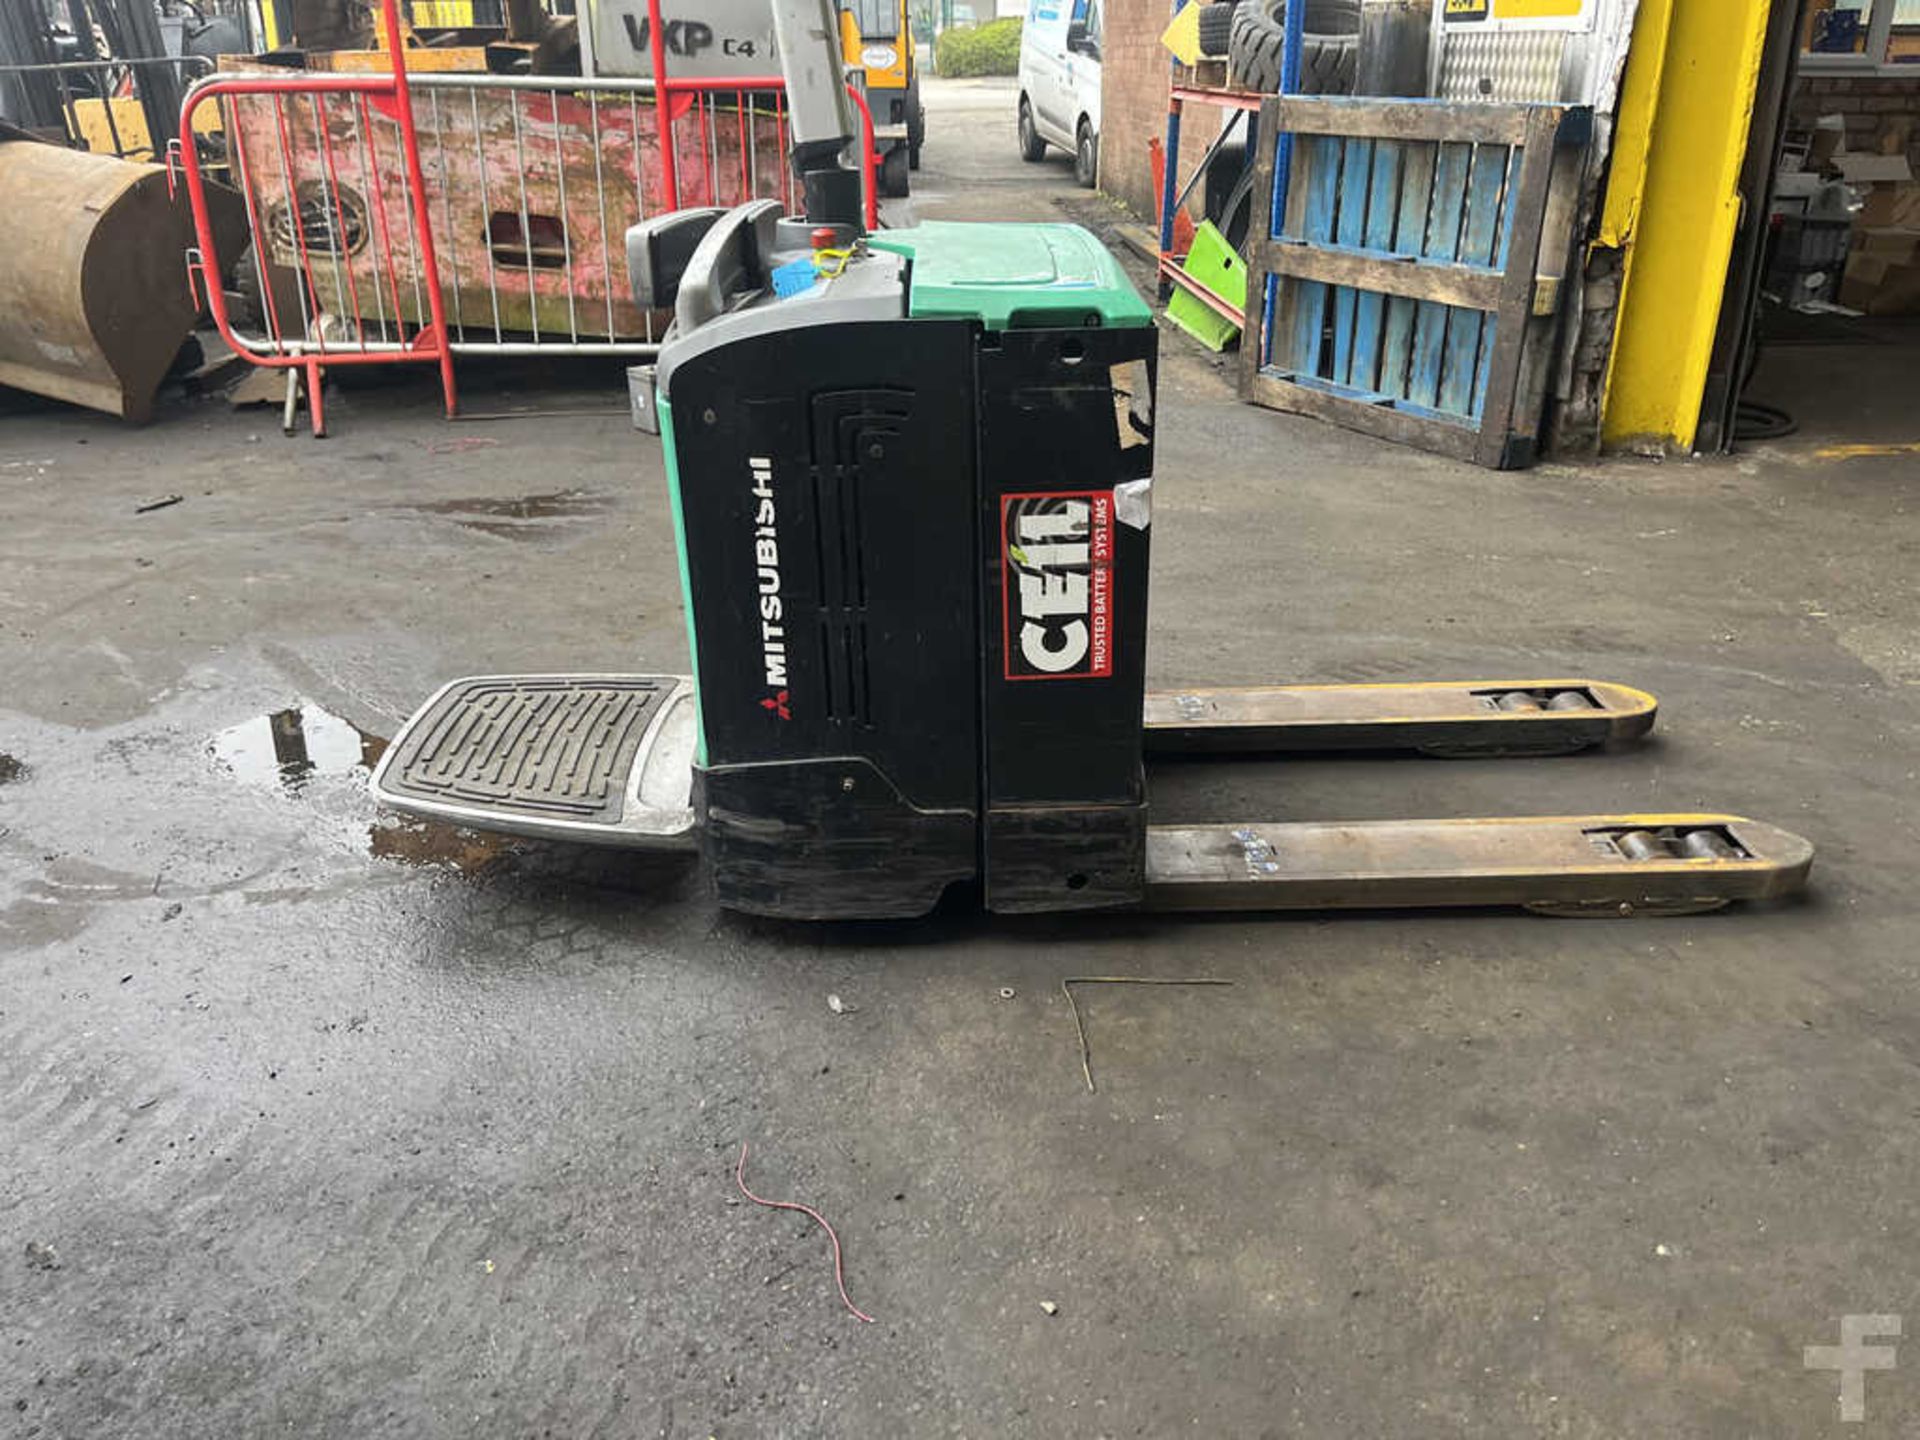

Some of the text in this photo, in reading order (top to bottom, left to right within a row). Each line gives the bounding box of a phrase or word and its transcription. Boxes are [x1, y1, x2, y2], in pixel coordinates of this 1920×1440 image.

[749, 456, 788, 687] MITSUBISHI
[1019, 500, 1090, 672] CEIL
[1094, 616, 1107, 671] TRUSTED
